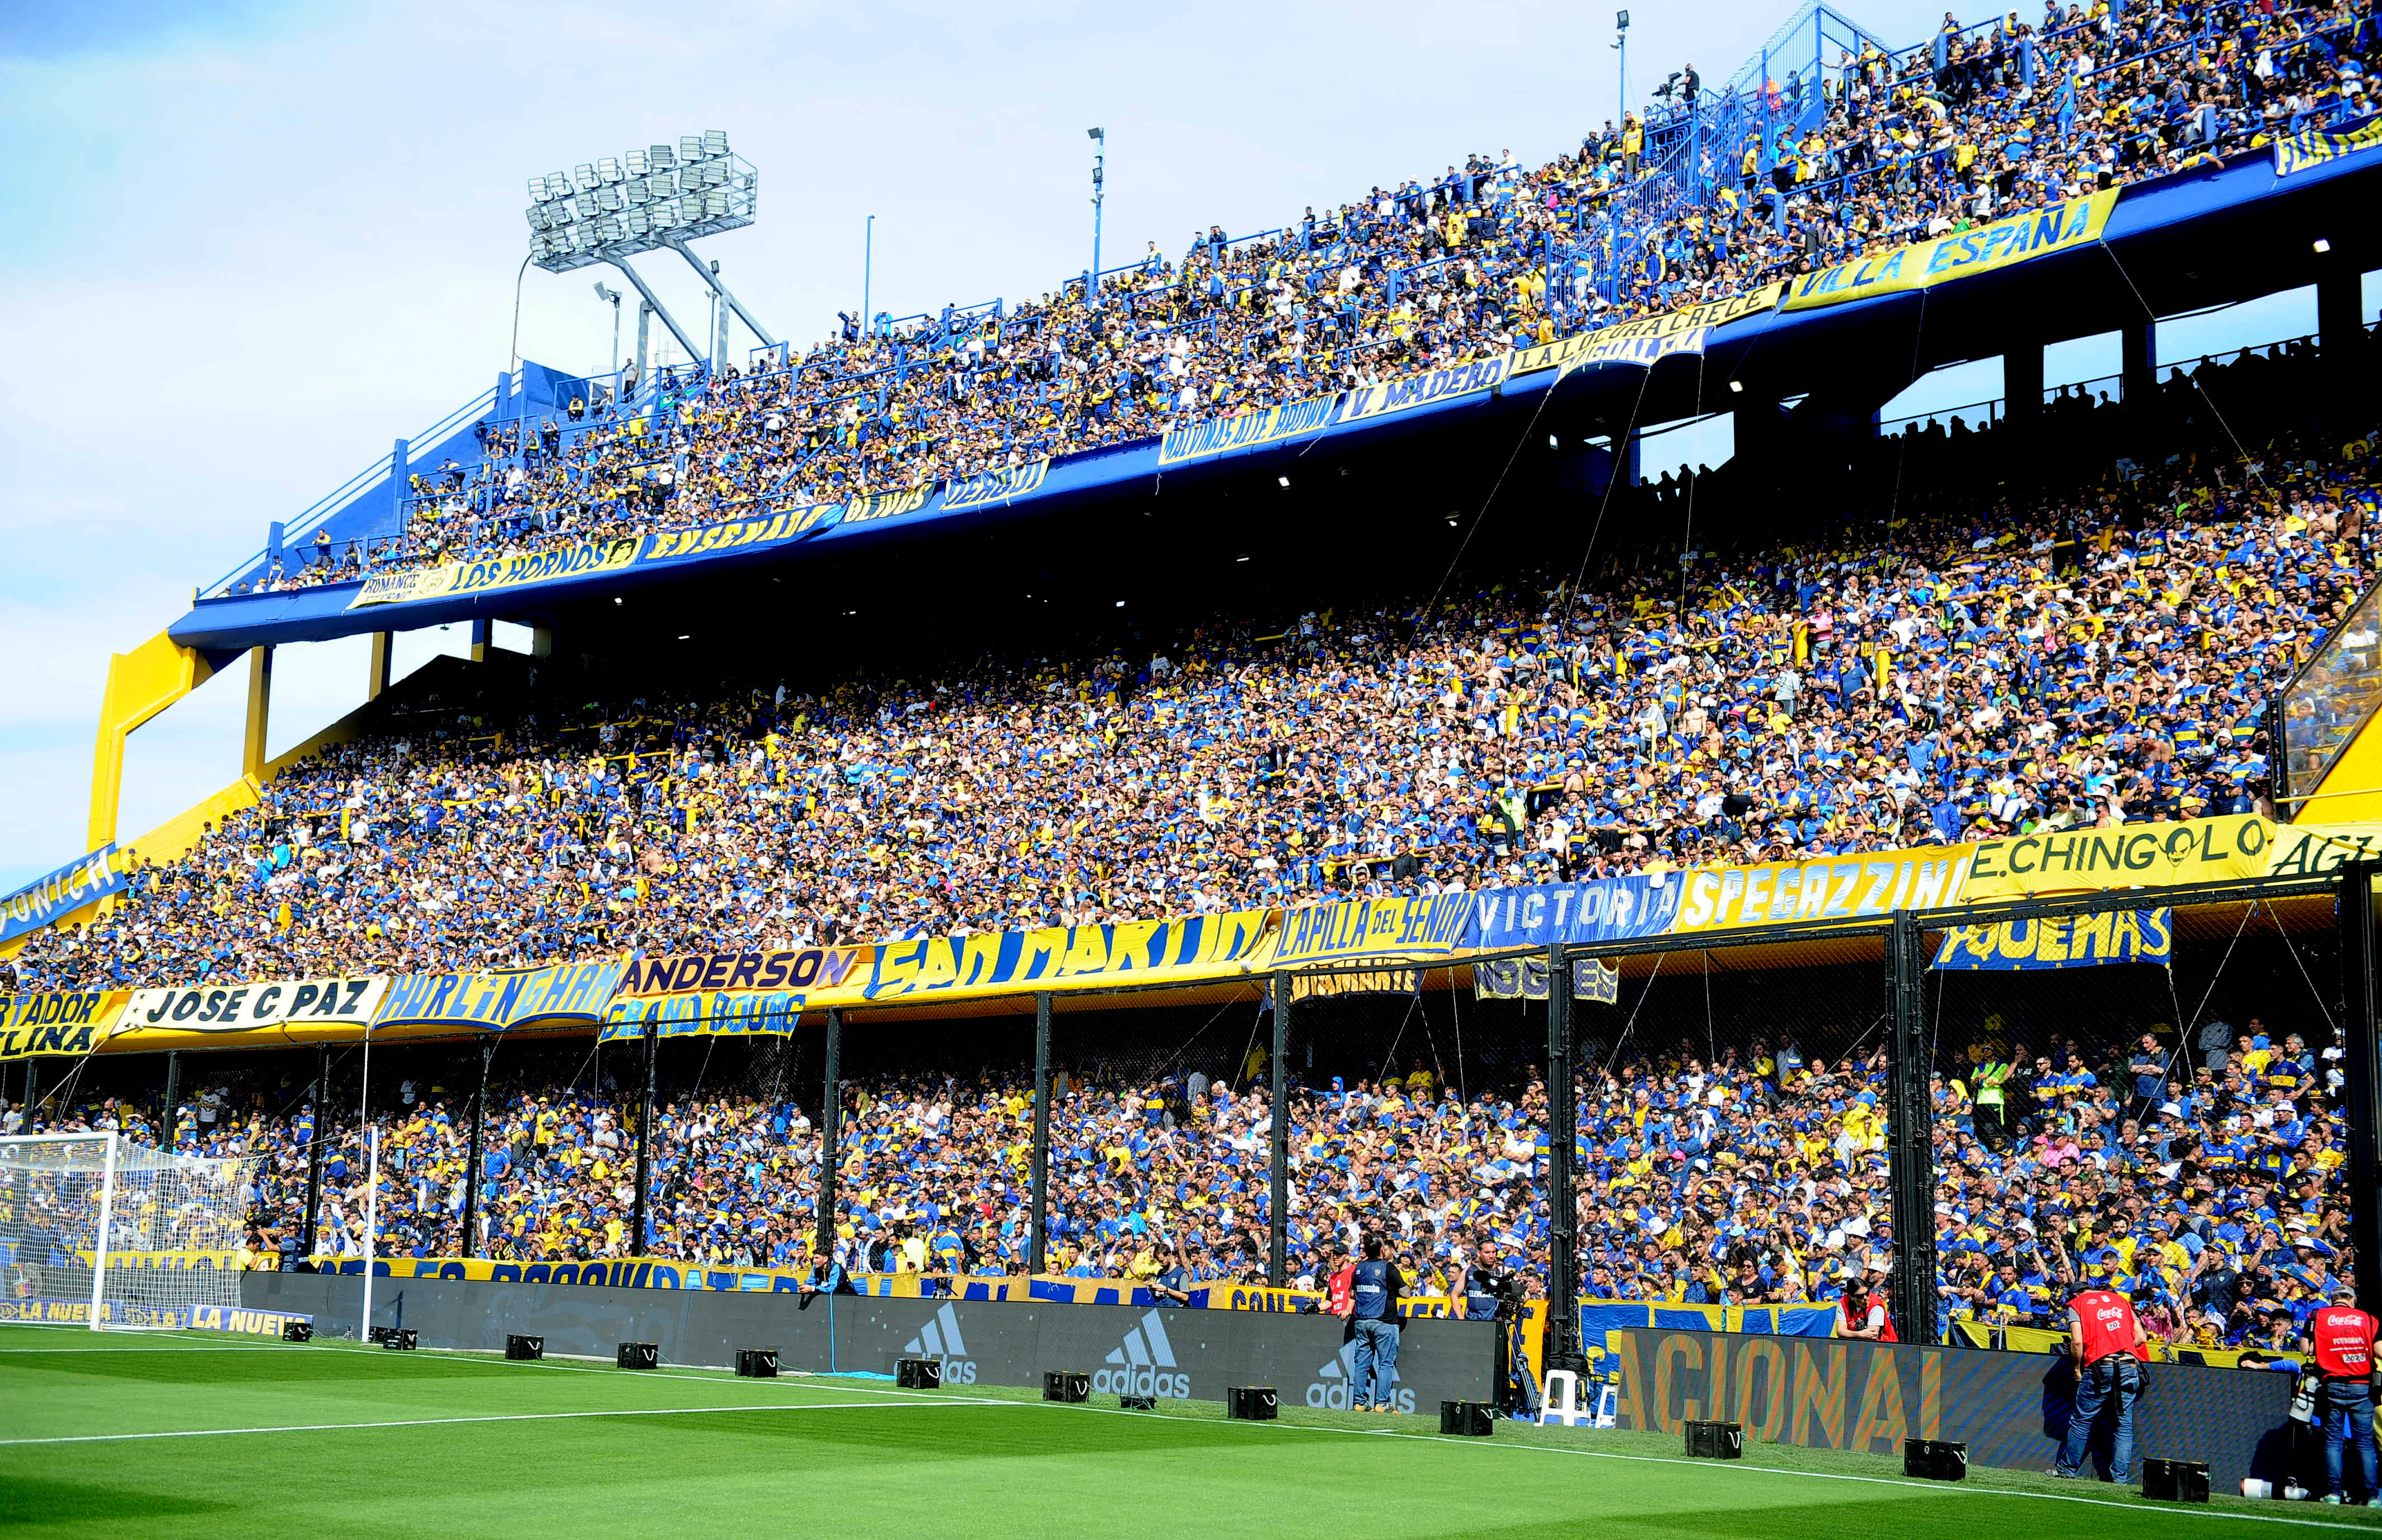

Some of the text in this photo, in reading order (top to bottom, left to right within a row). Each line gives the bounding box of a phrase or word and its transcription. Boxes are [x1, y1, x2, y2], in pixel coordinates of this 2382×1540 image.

[1799, 202, 2090, 296] VILLA ESPAÑA
[1521, 287, 1767, 369] LA LOCURA CRECE
[1386, 358, 1504, 408] MADERO
[845, 482, 932, 523] OLIVOS
[647, 505, 828, 560] ENSENADA
[364, 574, 420, 593] ROMANCE
[448, 562, 501, 591] LOS
[501, 542, 609, 586] HORNOS
[0, 847, 115, 936] ONICH
[1478, 881, 1676, 932] VICTORIA
[1684, 857, 1968, 926] SPEGAZZINI
[1280, 900, 1371, 954] CAPILLA
[1371, 909, 1398, 935] DEL
[618, 948, 858, 996] ANDERSON
[876, 910, 1270, 999] SAN MARTIN
[147, 989, 248, 1023] JOSE
[287, 981, 369, 1018] PAZ
[1473, 960, 1617, 1001] NOGES
[0, 1026, 95, 1056] LINA
[600, 992, 806, 1041] GRAND BOURG
[20, 1303, 41, 1319] LA
[192, 1307, 222, 1330] LA
[1093, 1364, 1190, 1398] adidas
